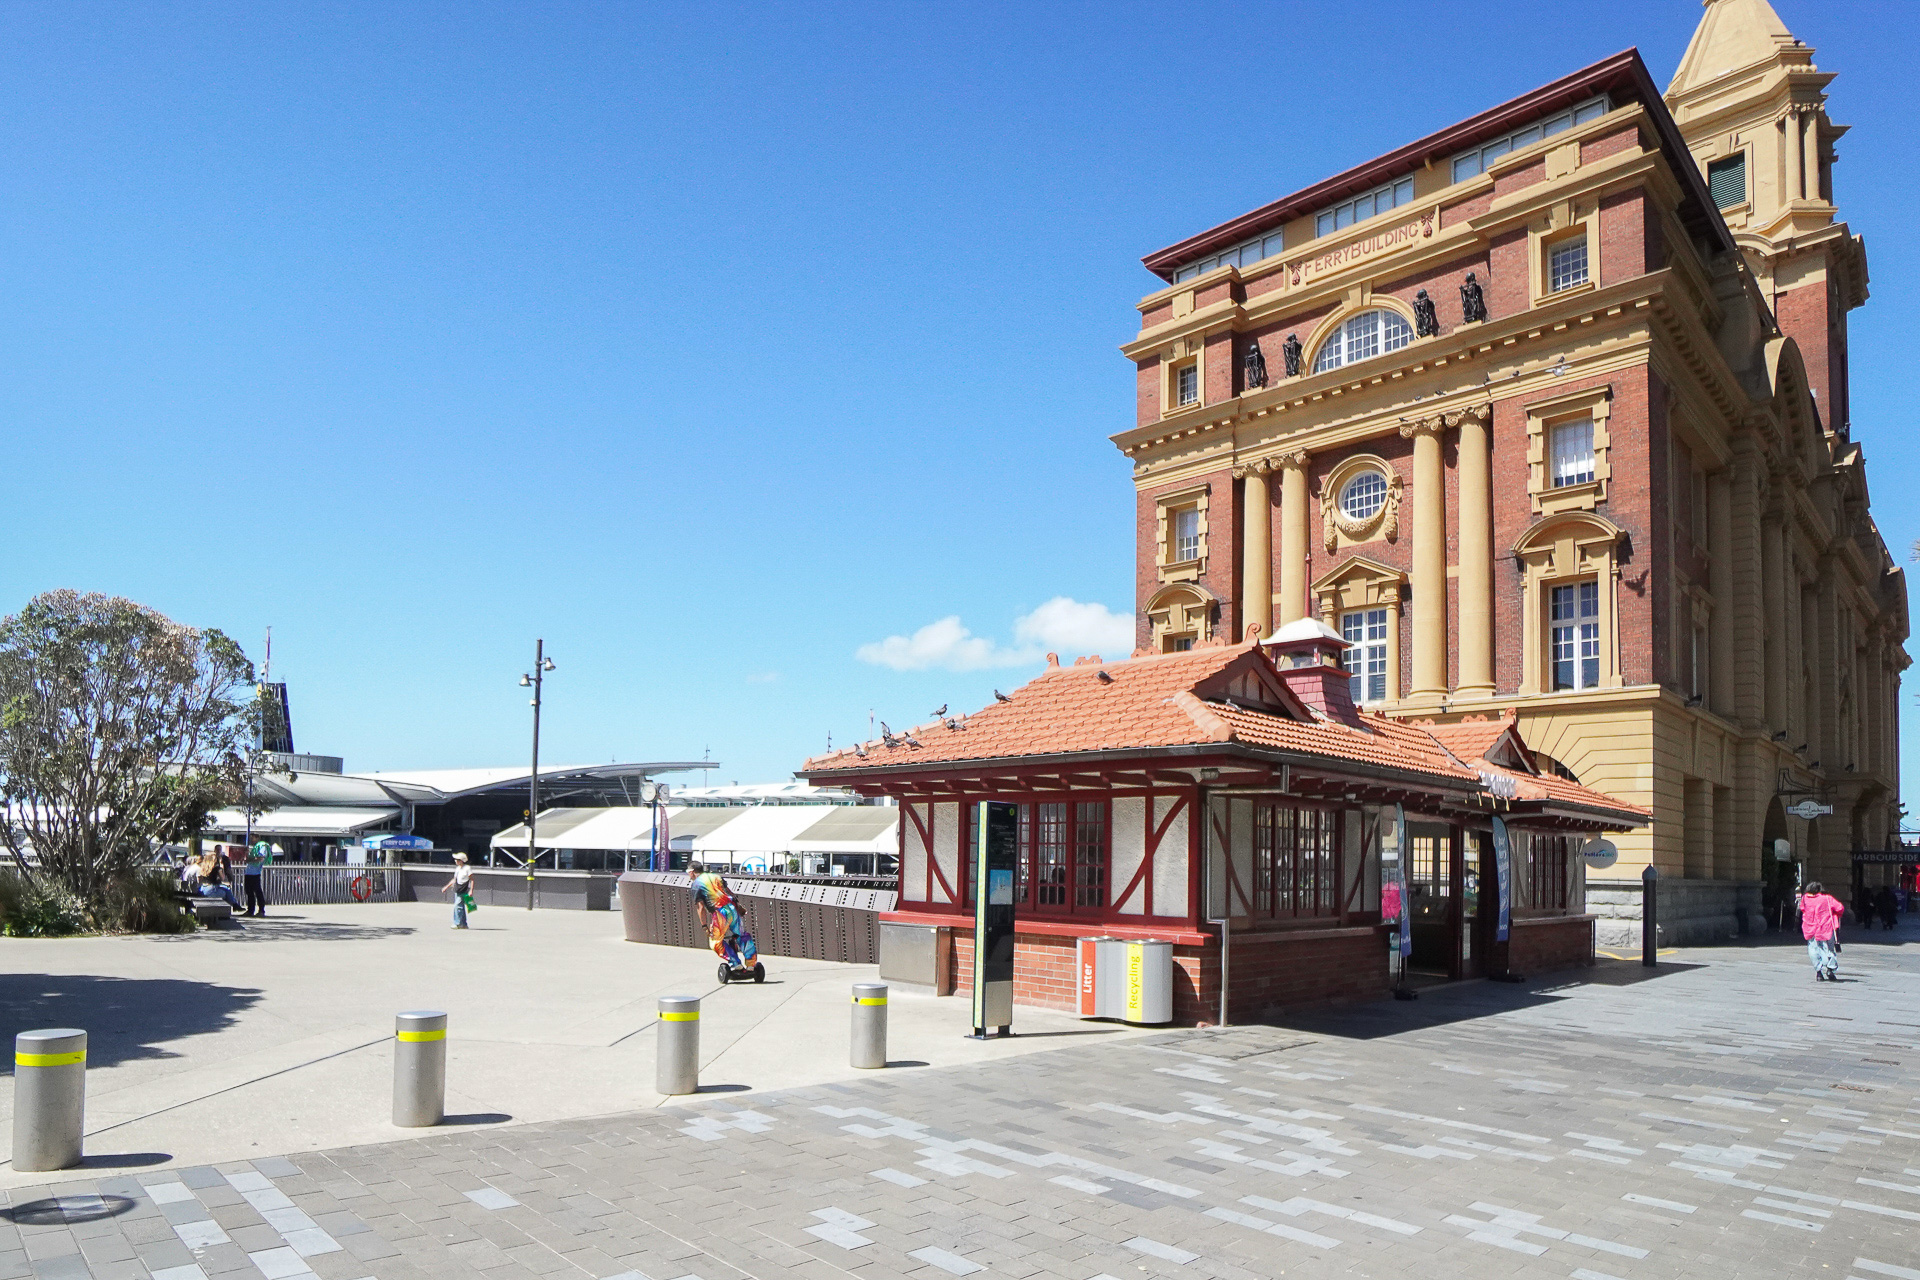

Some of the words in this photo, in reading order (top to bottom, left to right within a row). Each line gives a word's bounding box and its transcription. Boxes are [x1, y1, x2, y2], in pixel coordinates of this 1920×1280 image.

[1304, 247, 1350, 276] FERRY
[1351, 223, 1419, 259] BUILDING
[1851, 853, 1919, 861] HARBOURSIDE
[1083, 963, 1092, 993] Litter
[1129, 956, 1140, 1009] Recycling
